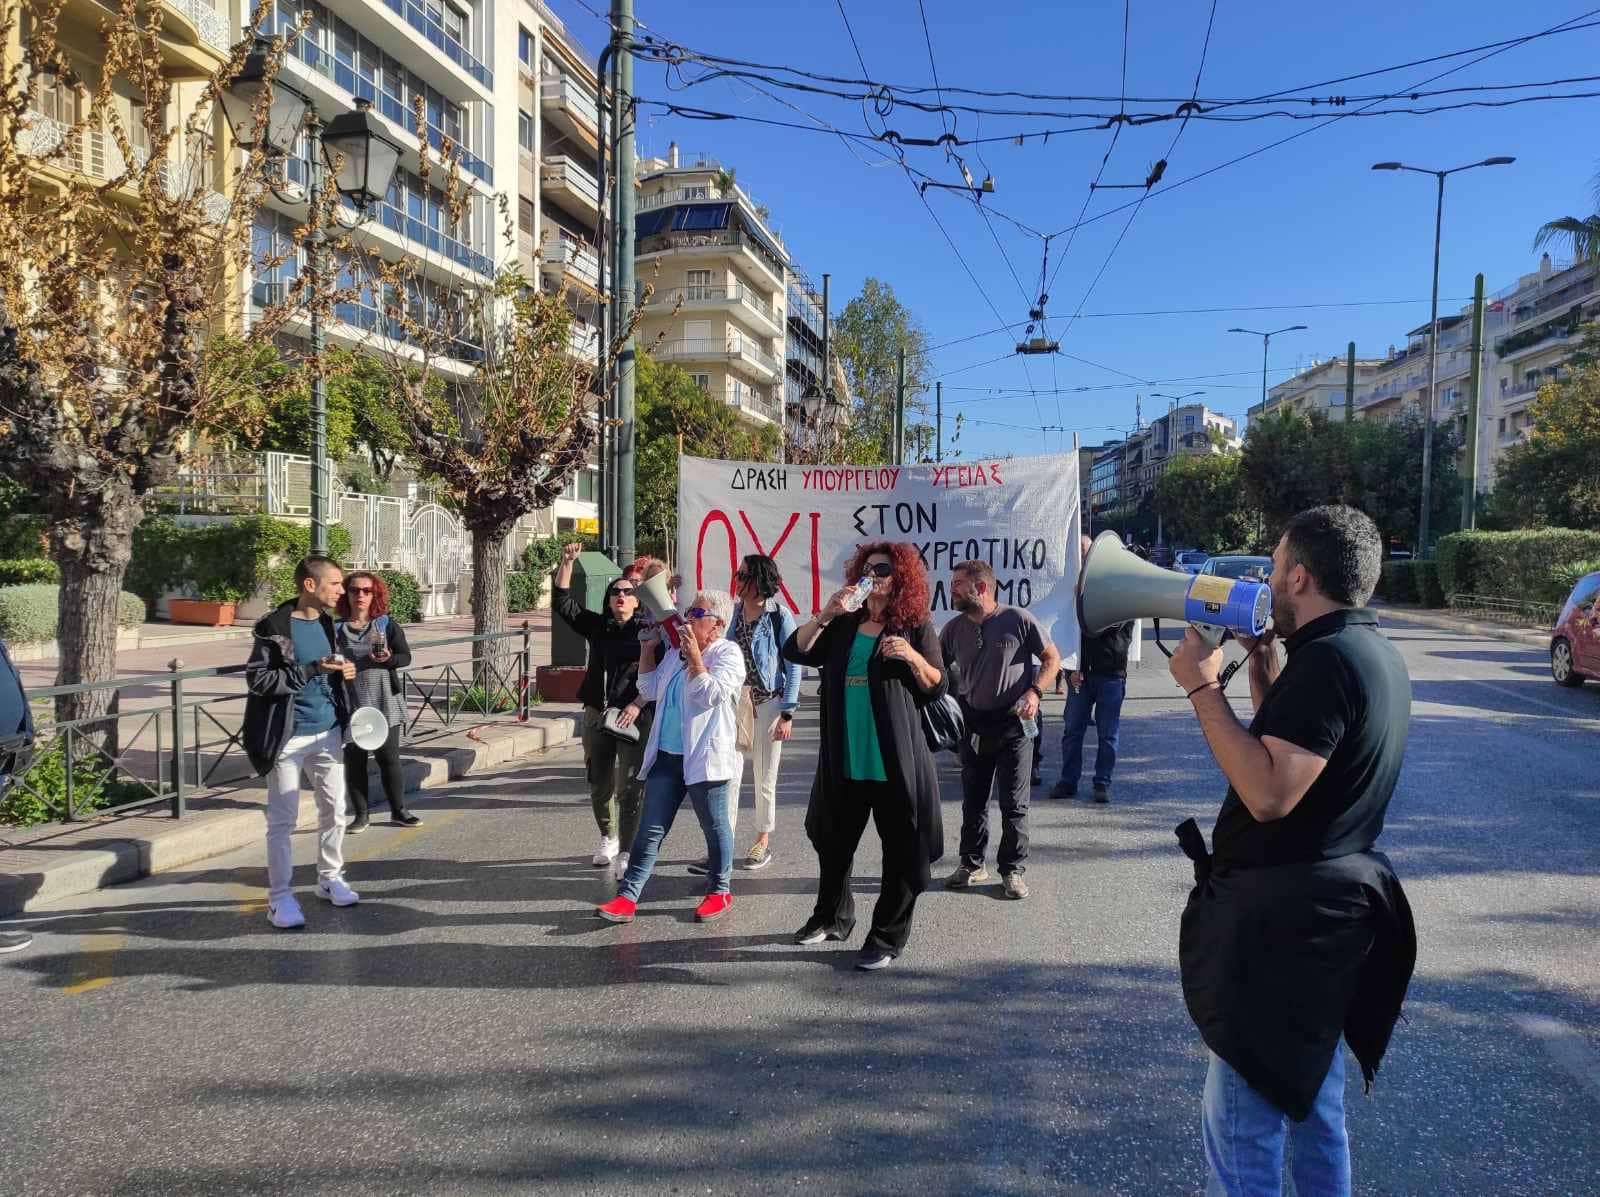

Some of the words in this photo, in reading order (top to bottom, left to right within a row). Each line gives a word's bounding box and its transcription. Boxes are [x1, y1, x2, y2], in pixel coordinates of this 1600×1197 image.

[731, 467, 787, 491] ΔΡΑΣΗ
[801, 468, 901, 491] ΥΠΟΥΡΓΕΙΟΥ
[932, 463, 1003, 489] ΥΓΕΙΑΣ
[853, 502, 937, 536] ΣΤΟΝ
